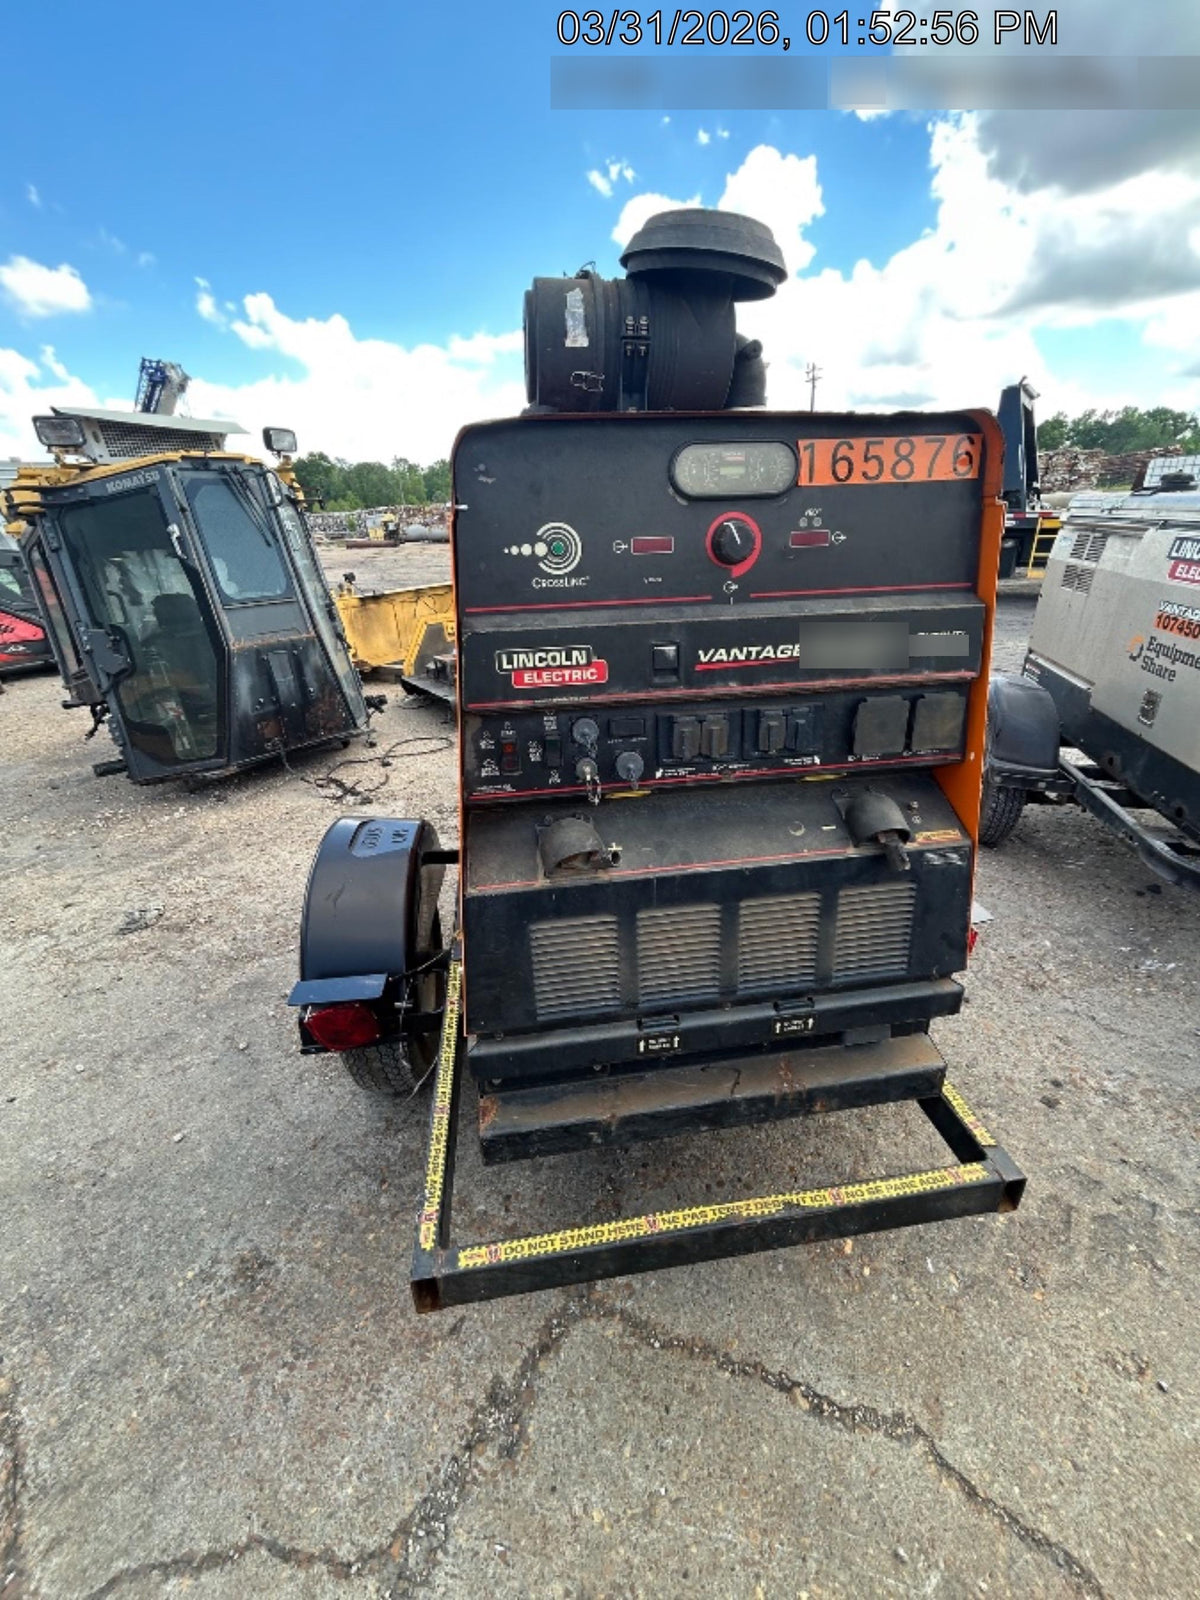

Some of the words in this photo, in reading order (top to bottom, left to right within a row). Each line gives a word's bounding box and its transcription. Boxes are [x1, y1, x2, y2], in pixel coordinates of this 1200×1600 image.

[803, 435, 976, 483] 165876
[1156, 612, 1200, 639] 107450
[501, 650, 587, 670] LINCOLN
[1141, 655, 1176, 682] Share
[524, 668, 598, 683] ELECTRIC
[844, 1188, 865, 1200] NO
[885, 1180, 917, 1194] PARE
[919, 1174, 949, 1187] AQUI
[504, 1243, 525, 1256] DO
[527, 1238, 555, 1251] NOT
[559, 1228, 605, 1246] STAND
[607, 1223, 644, 1237] HERE
